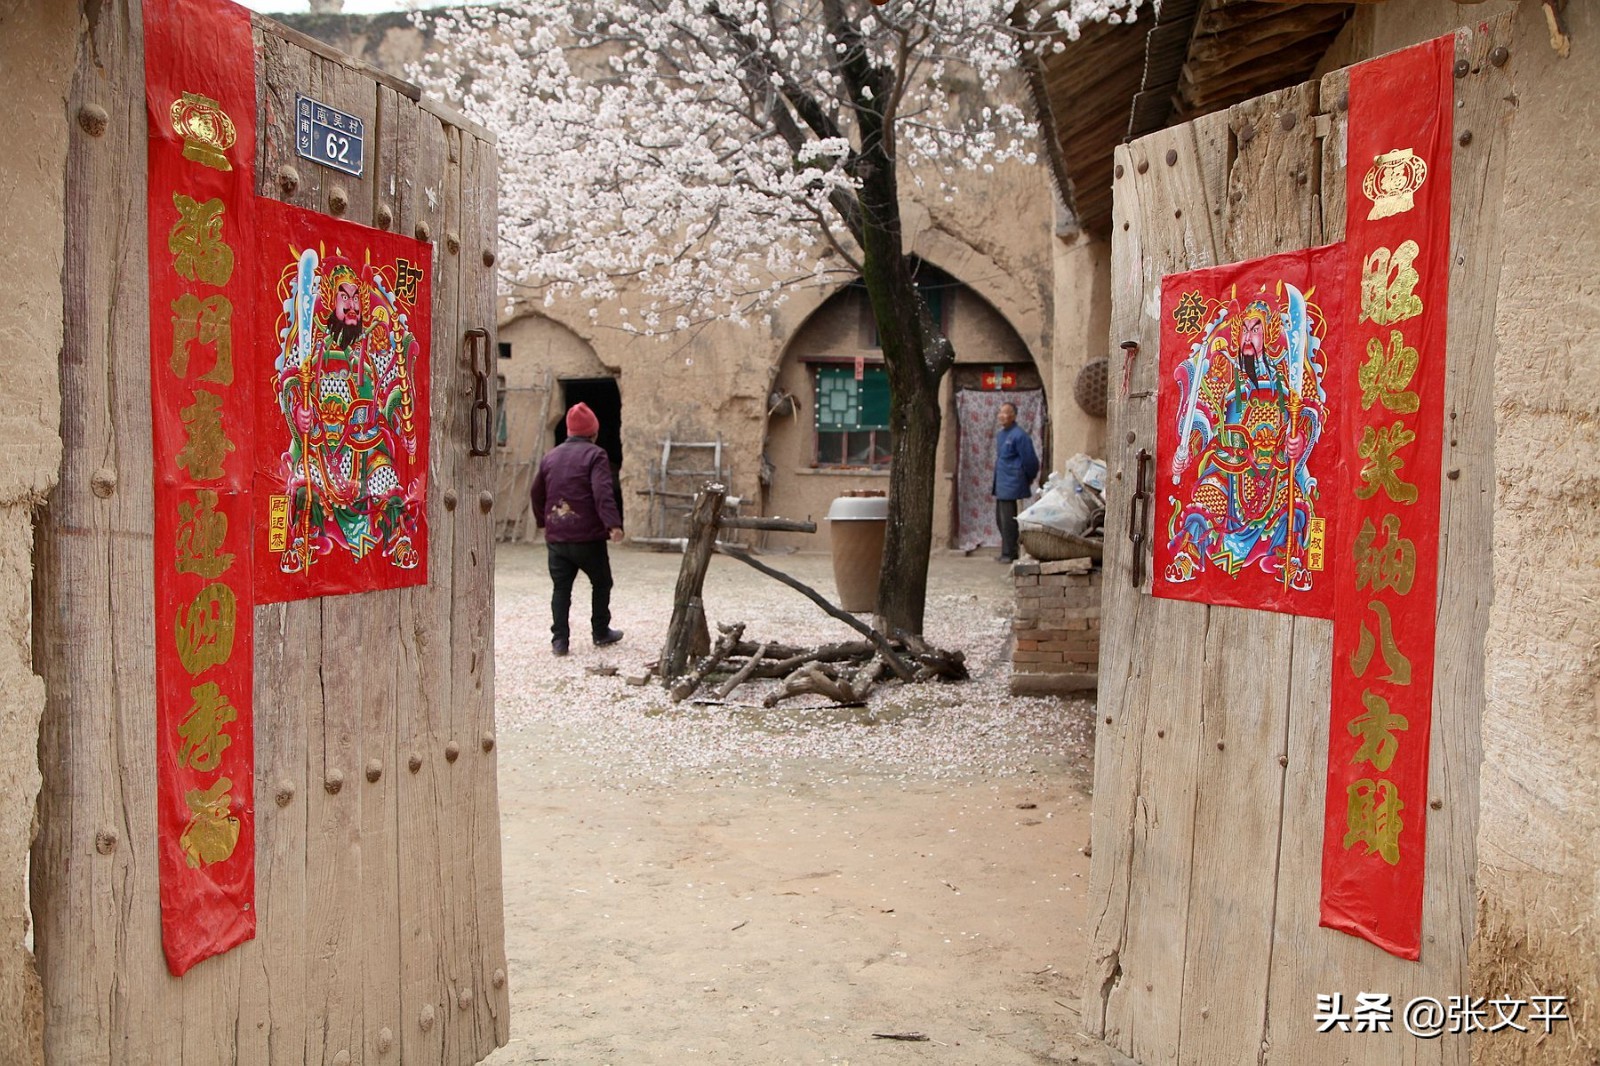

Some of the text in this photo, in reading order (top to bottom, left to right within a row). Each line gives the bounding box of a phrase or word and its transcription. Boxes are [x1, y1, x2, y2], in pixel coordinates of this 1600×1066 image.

[317, 107, 358, 134] 南吴村
[326, 133, 349, 163] 62
[394, 258, 424, 306] 財
[1173, 290, 1208, 333] 發
